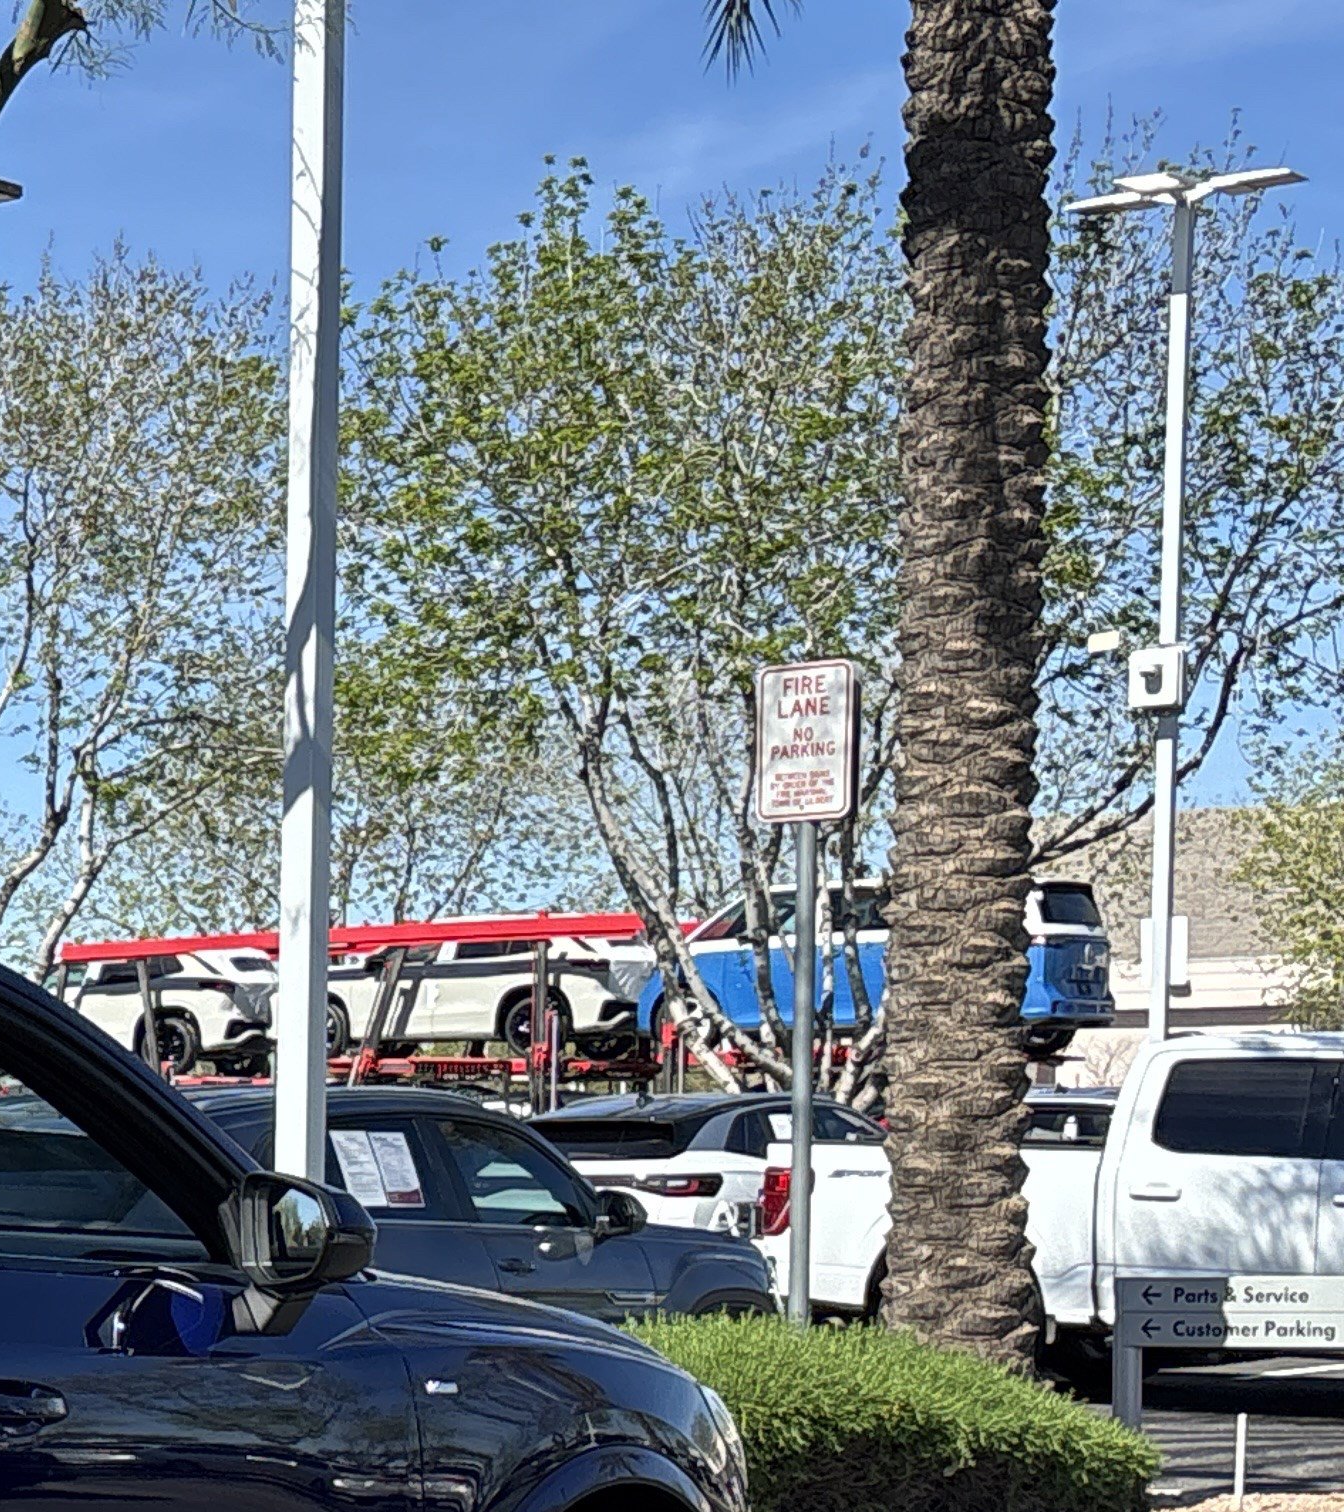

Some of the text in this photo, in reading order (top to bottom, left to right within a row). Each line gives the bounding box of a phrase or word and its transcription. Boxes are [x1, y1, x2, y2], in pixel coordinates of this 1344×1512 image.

[782, 674, 827, 698] FIRE
[777, 696, 831, 720] LANE
[792, 726, 815, 742] NO
[770, 740, 836, 761] PARKING
[1173, 1285, 1310, 1304] Parts & Service
[1172, 1319, 1336, 1342] Customer Parking
